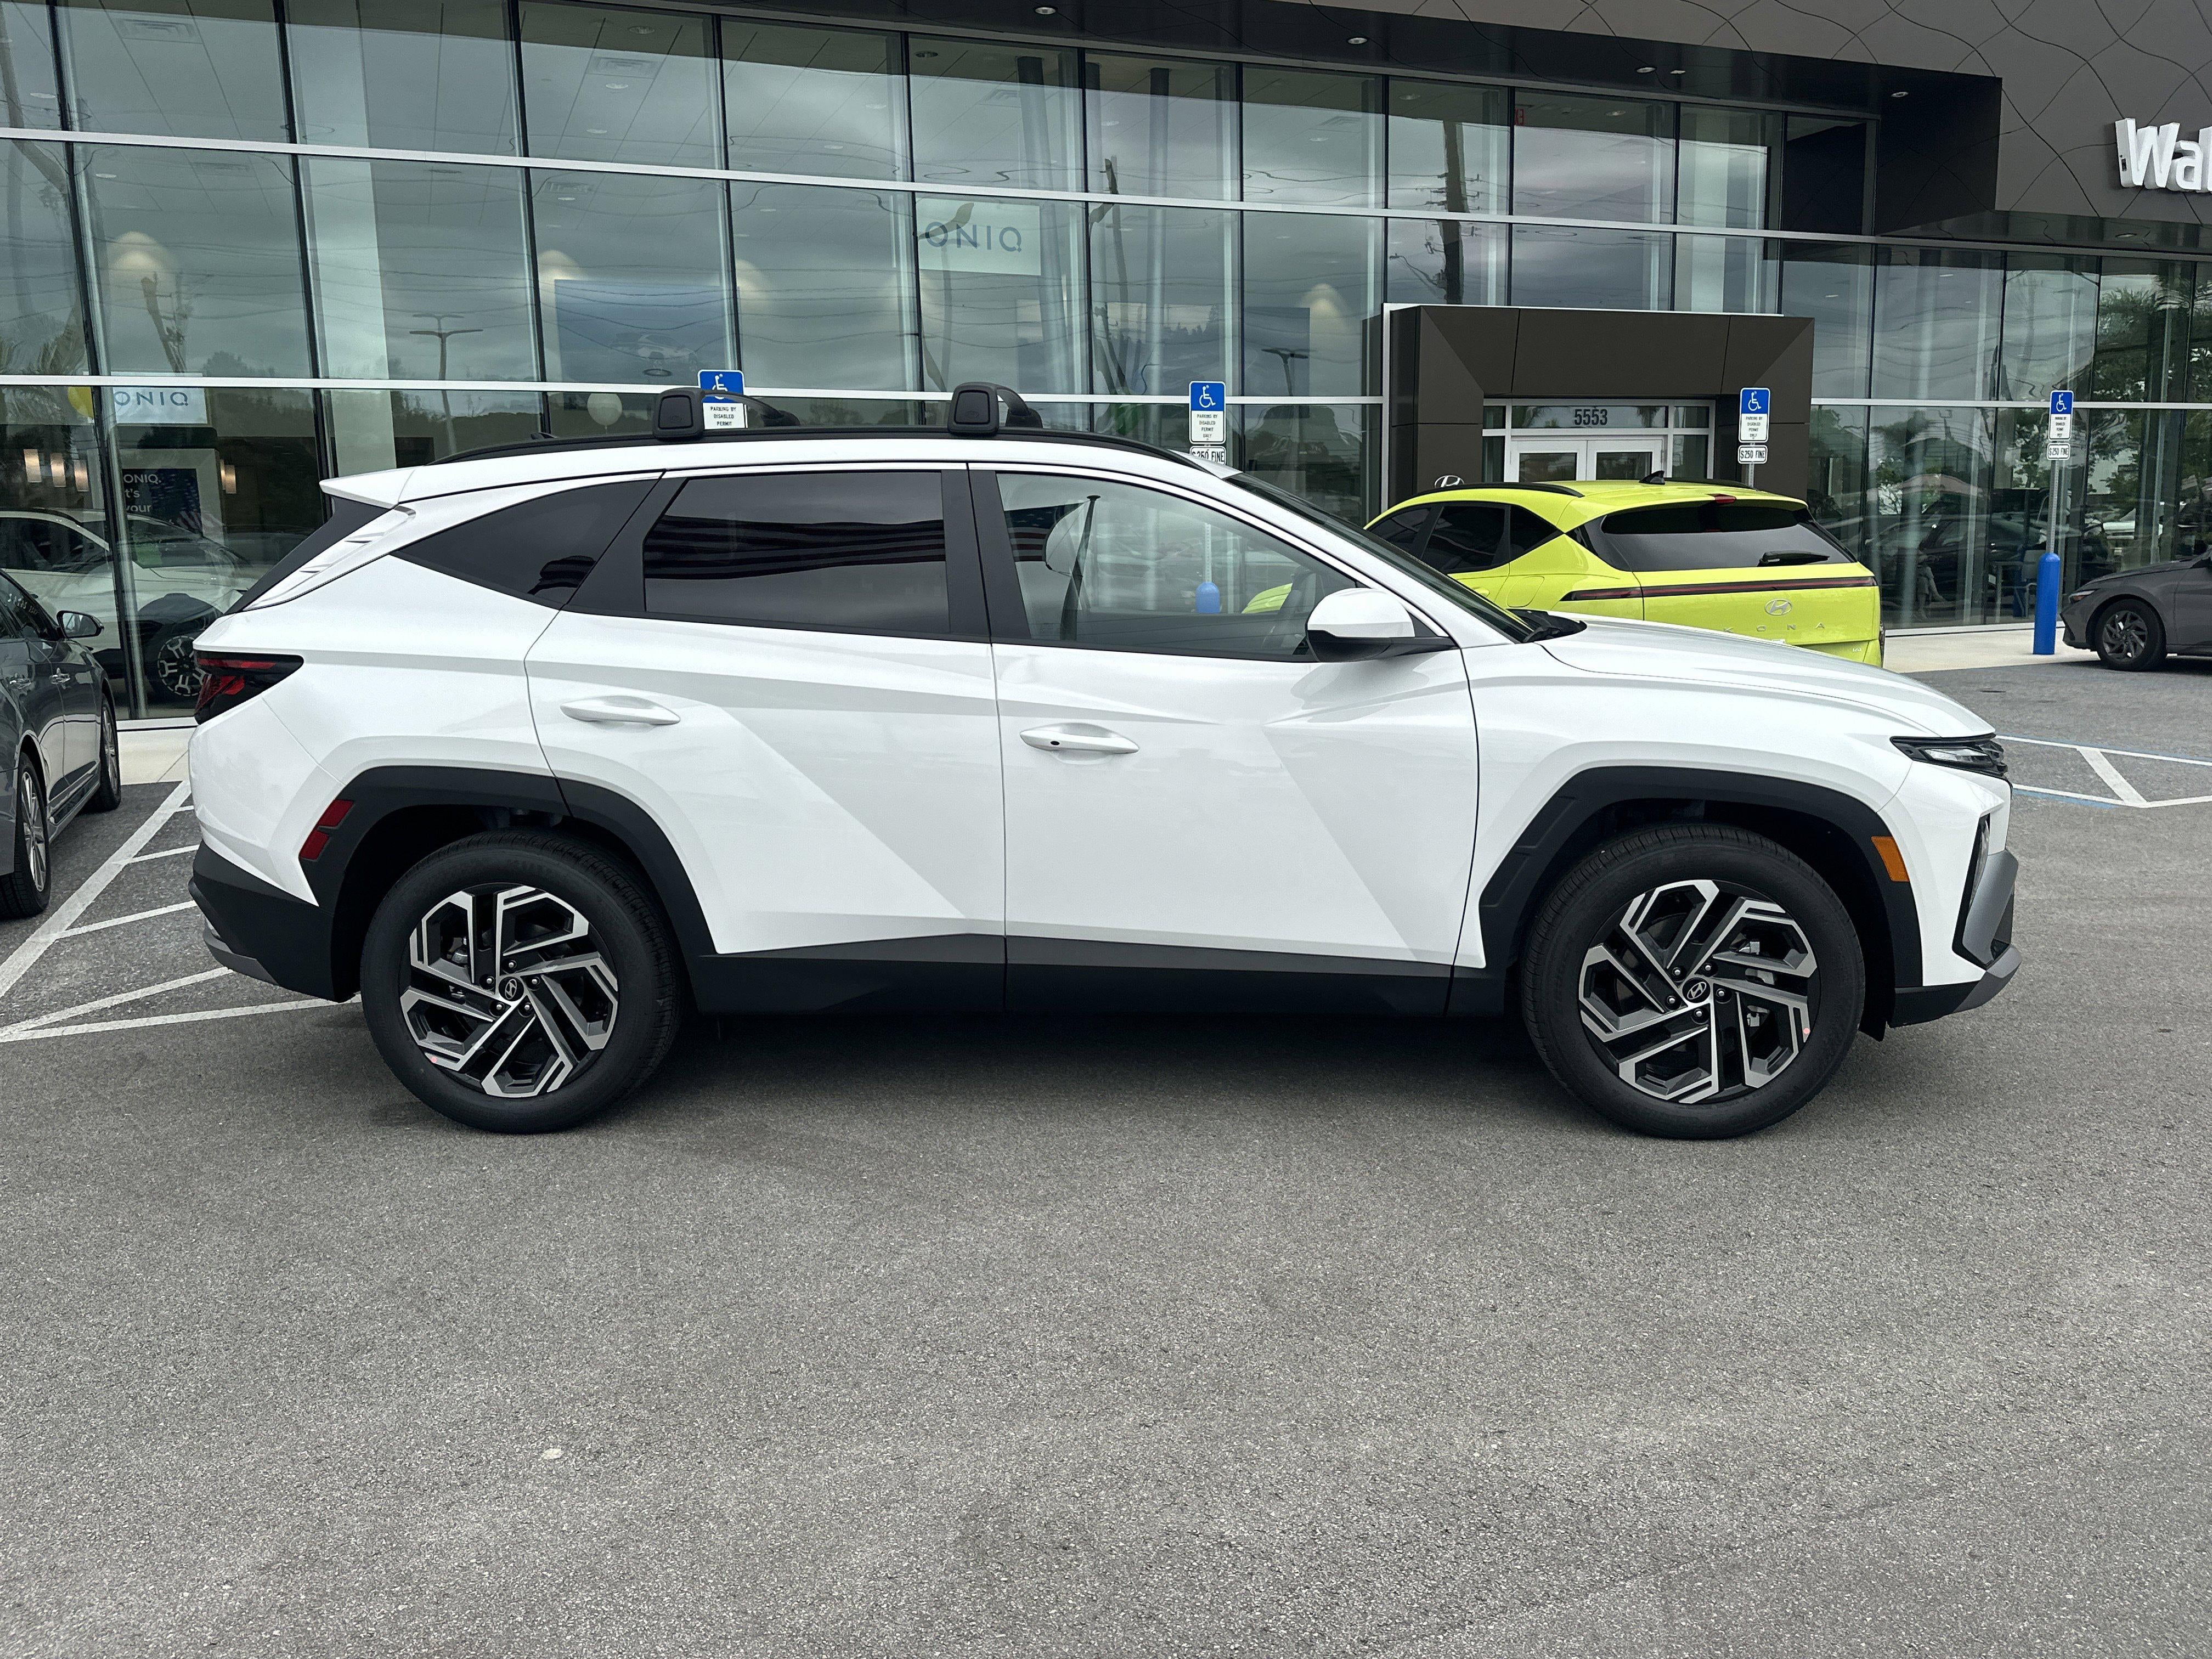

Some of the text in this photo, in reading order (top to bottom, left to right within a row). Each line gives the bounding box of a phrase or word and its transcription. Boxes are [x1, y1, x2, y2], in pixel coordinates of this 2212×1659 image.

[925, 221, 1022, 253] ONIQ
[114, 391, 189, 407] ONIQ
[1574, 409, 1608, 425] 5553
[1211, 451, 1225, 463] FINE
[1740, 450, 1765, 459] $250 FINE
[1723, 622, 1825, 633] KONA
